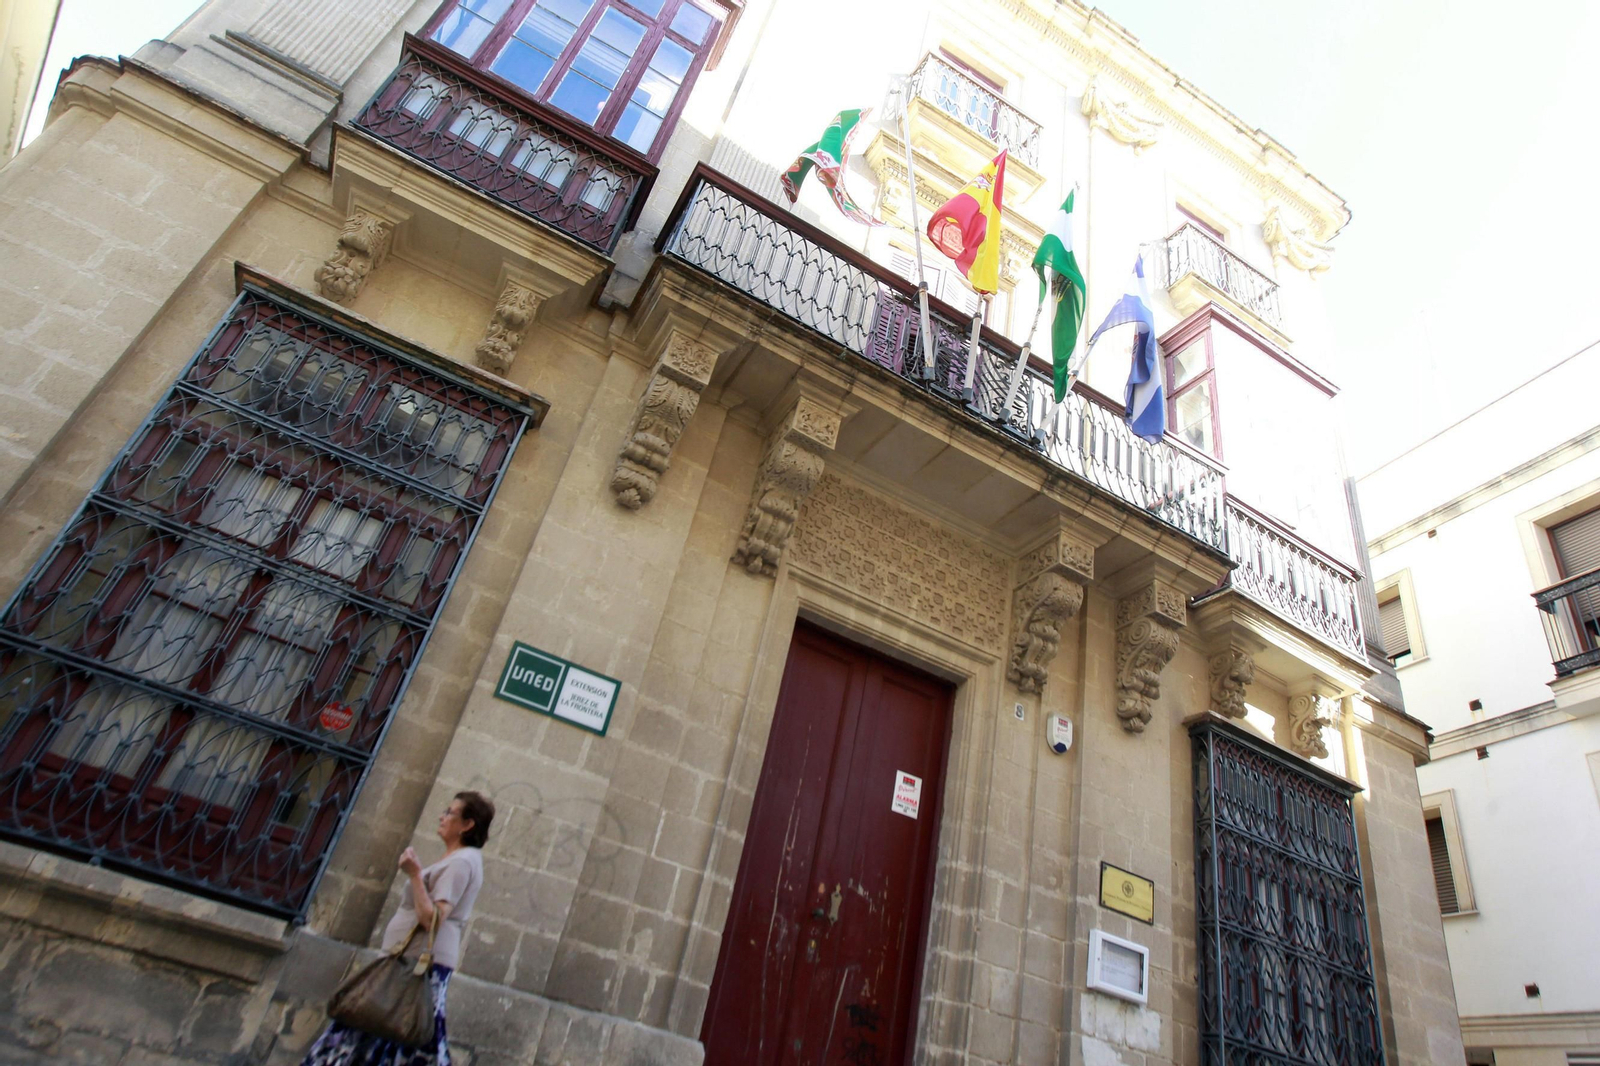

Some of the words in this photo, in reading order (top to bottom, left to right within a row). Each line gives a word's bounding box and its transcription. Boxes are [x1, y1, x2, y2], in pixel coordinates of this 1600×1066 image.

[511, 665, 555, 692] UNED
[570, 678, 608, 699] EXTENSIÓN
[560, 698, 569, 707] LA
[570, 702, 603, 719] FRONTERA
[570, 693, 590, 705] JEREZ
[590, 700, 600, 709] DE
[1015, 704, 1024, 718] 8
